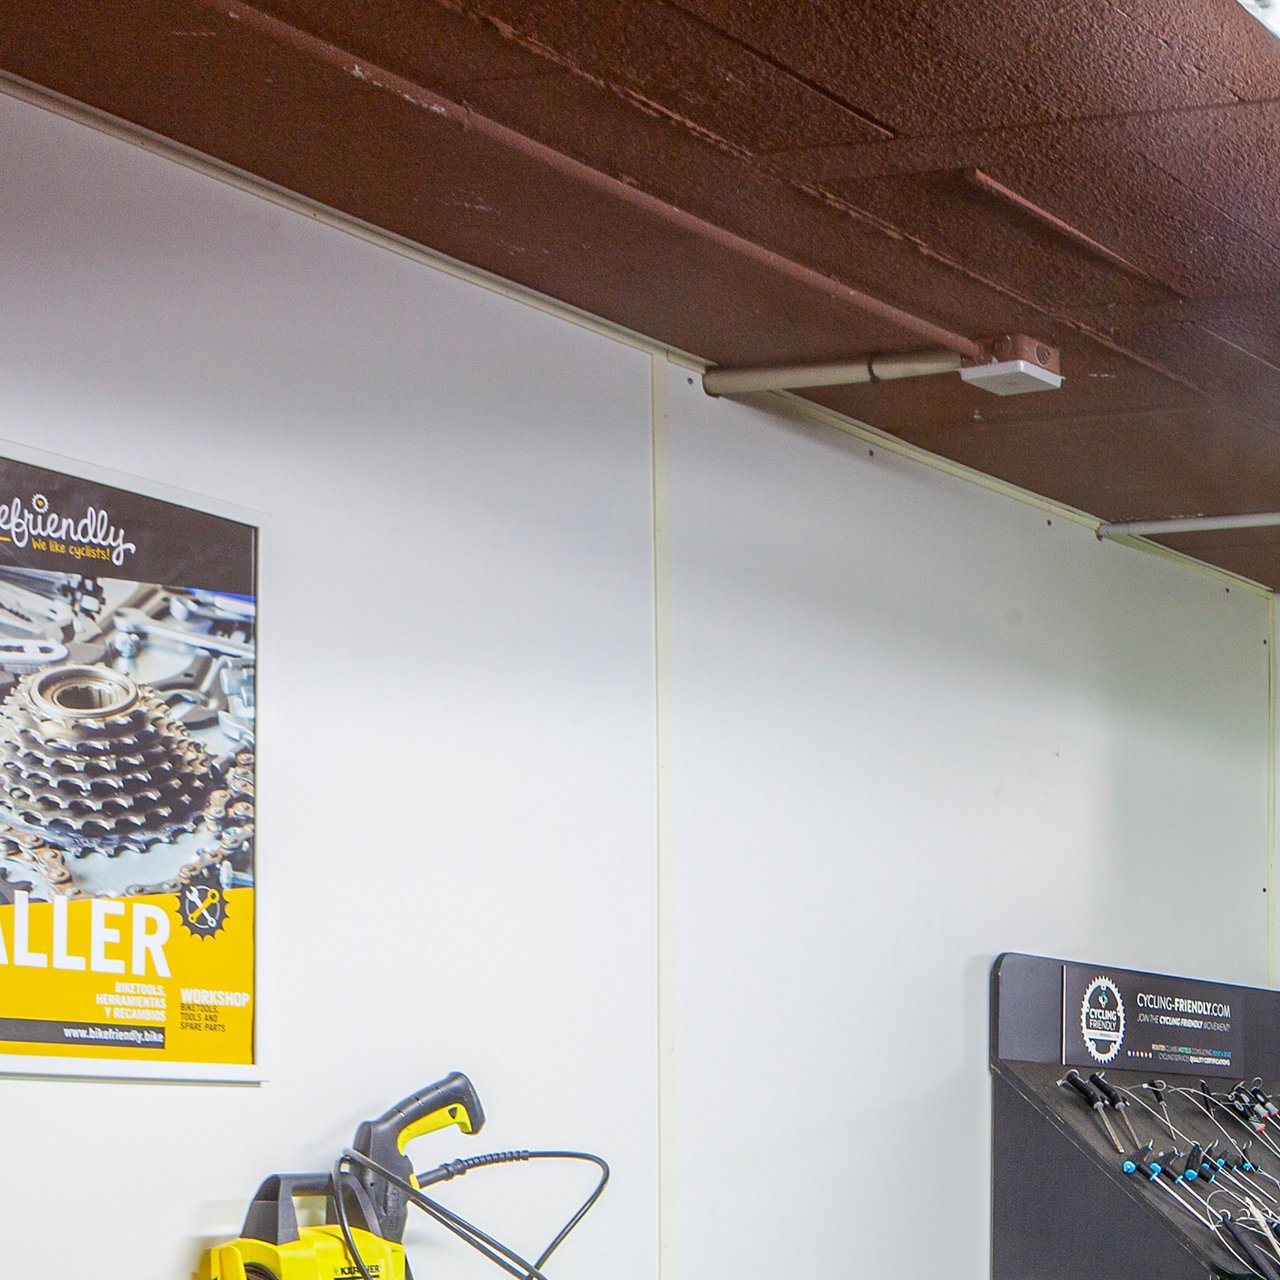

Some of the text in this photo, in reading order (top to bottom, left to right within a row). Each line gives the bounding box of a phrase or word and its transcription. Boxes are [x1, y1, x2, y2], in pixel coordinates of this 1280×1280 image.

[32, 538, 110, 560] We like cyclists!
[0, 890, 172, 978] LLER
[96, 994, 167, 1009] HERRAMIENTAS
[180, 988, 250, 1008] WORKSHOP
[1136, 992, 1231, 1018] CYCLING-FRIENDLY.COM
[104, 1007, 167, 1022] Y RECAMBIOS
[180, 1013, 218, 1023] TOOLS AND
[1090, 1008, 1117, 1021] CYCLING
[1137, 1013, 1149, 1022] JOIN
[1159, 1015, 1180, 1027] CYCLING
[1180, 1017, 1204, 1029] FRIENDLY
[180, 1022, 226, 1032] SPARE PARTS
[1090, 1019, 1117, 1031] FRIENDLY
[63, 1027, 164, 1043] www.bikefriendly.bike
